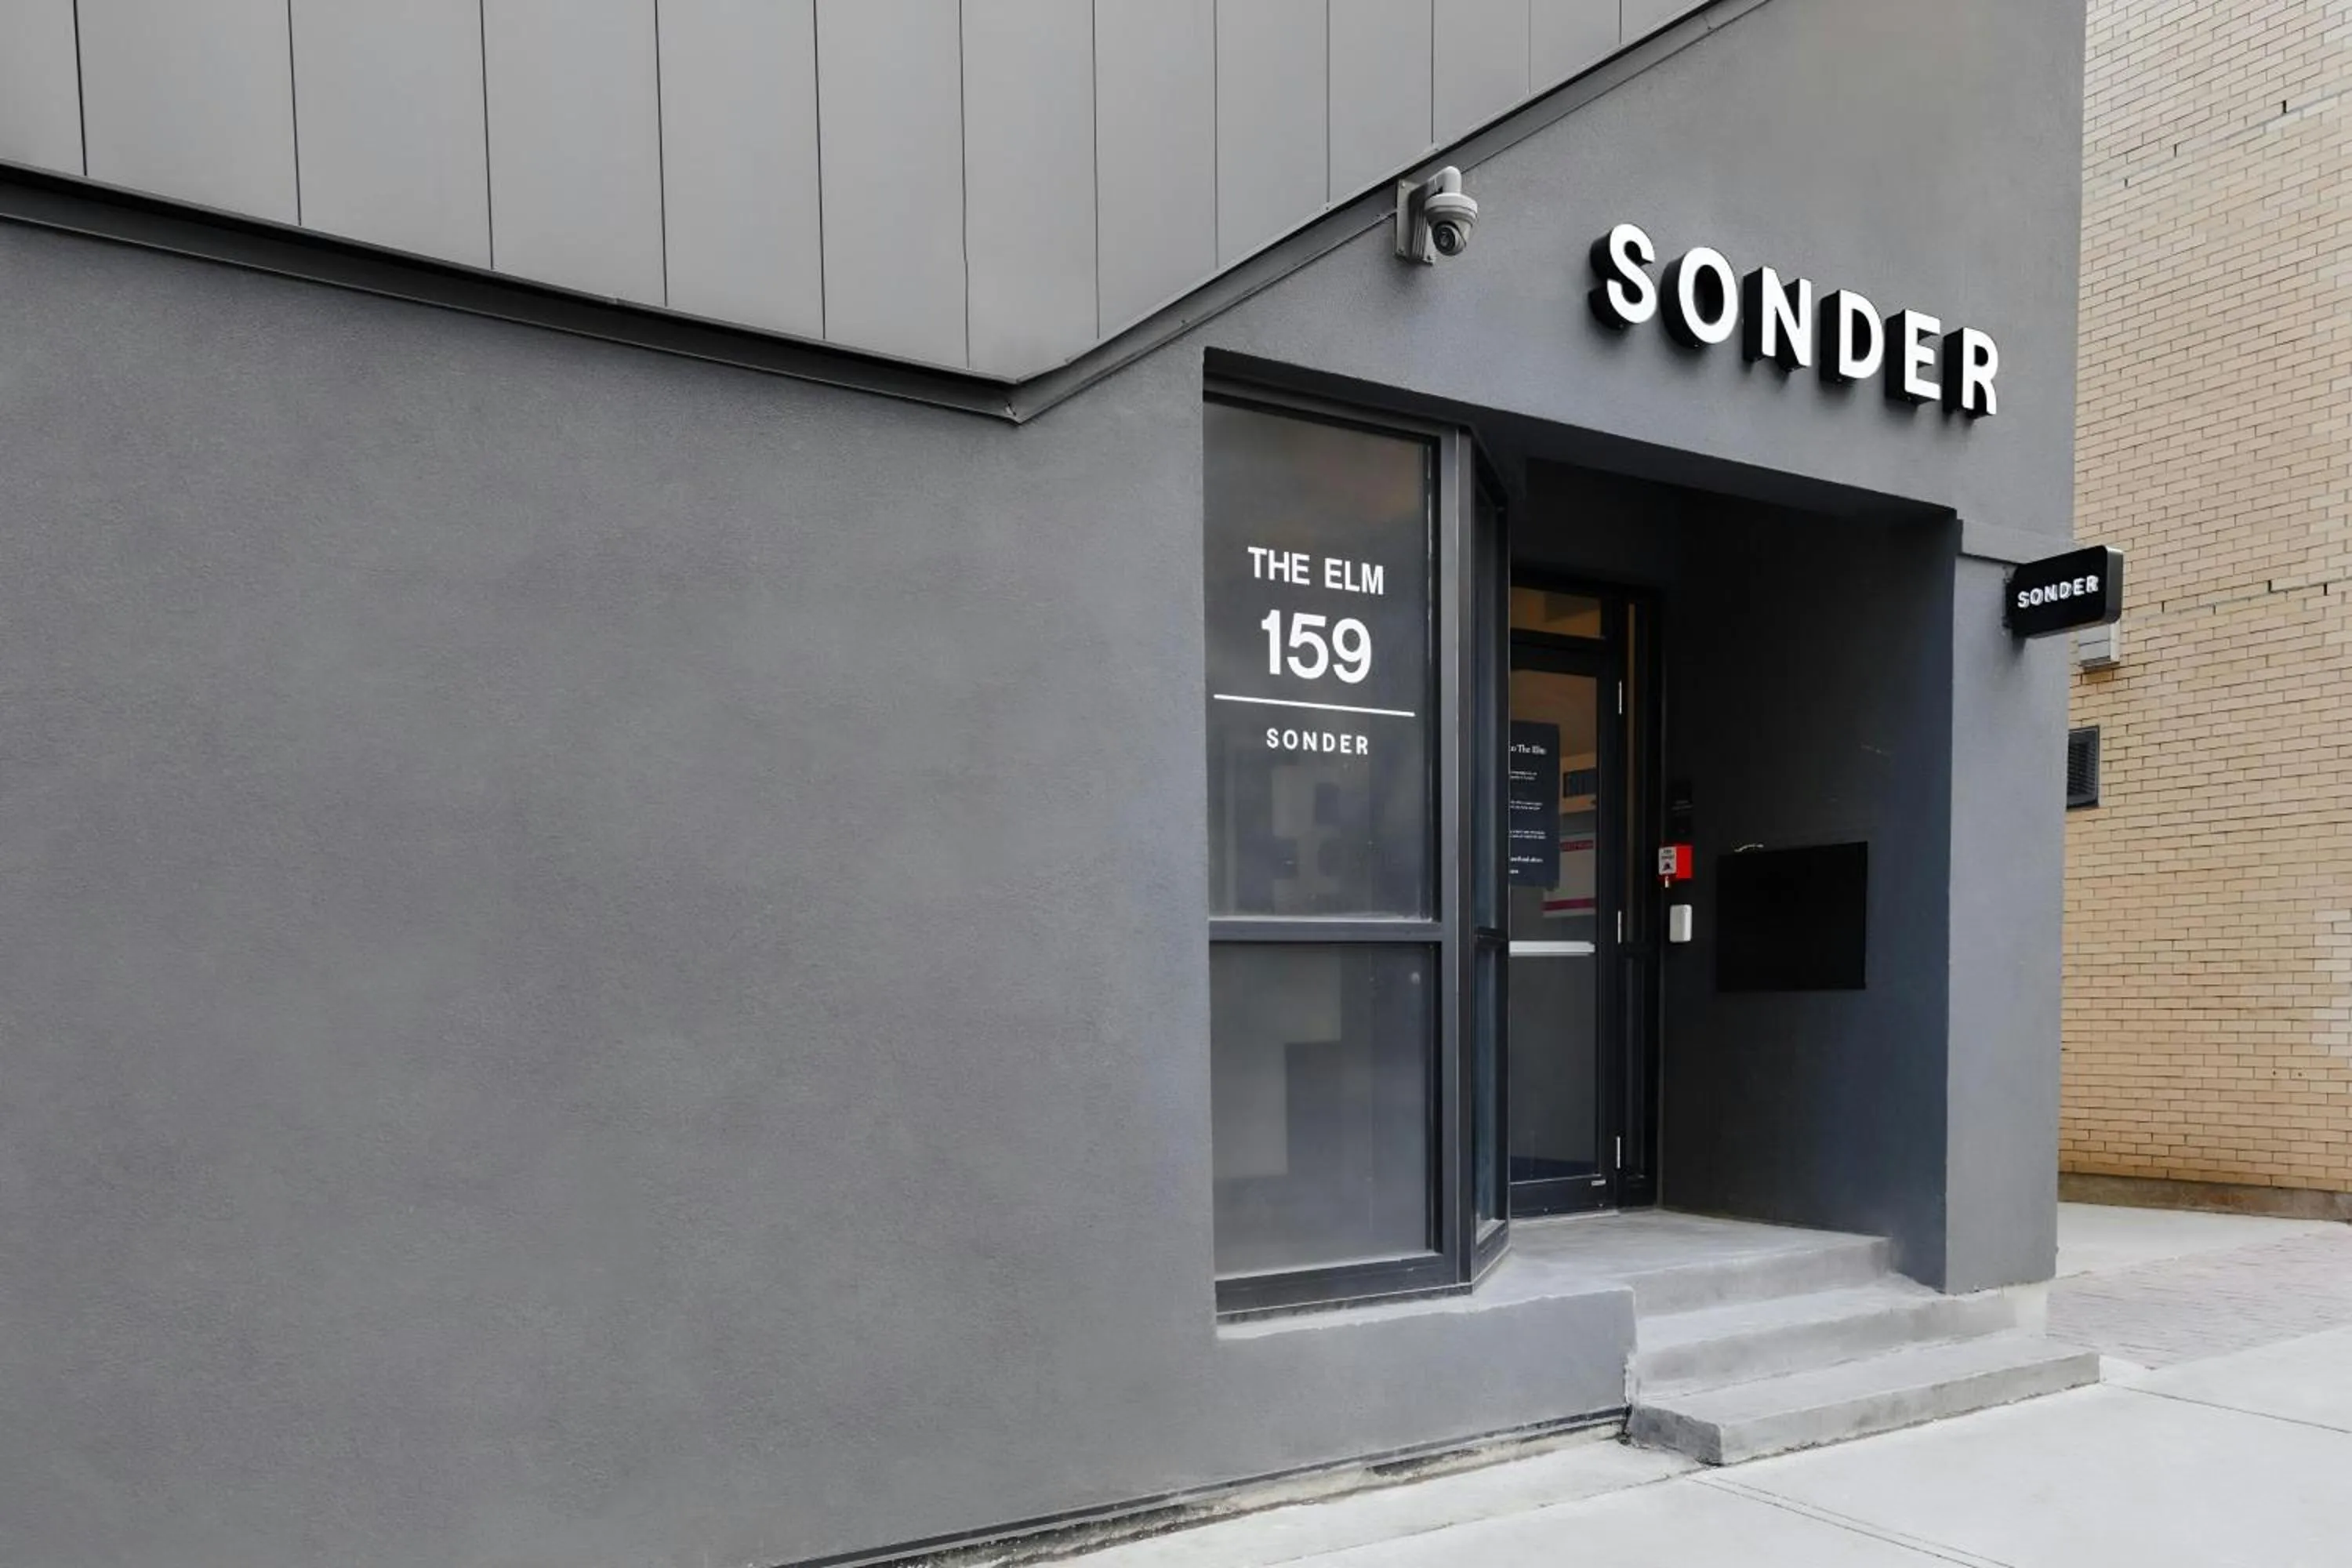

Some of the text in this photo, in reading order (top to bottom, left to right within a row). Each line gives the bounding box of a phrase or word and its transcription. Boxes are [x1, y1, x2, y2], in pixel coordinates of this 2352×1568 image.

[1607, 223, 1998, 415] SONDER
[1247, 546, 1384, 595] THE ELM
[2017, 575, 2099, 608] SONDER
[1261, 609, 1371, 684] 159
[1266, 728, 1368, 755] SONDER
[1516, 744, 1530, 753] The
